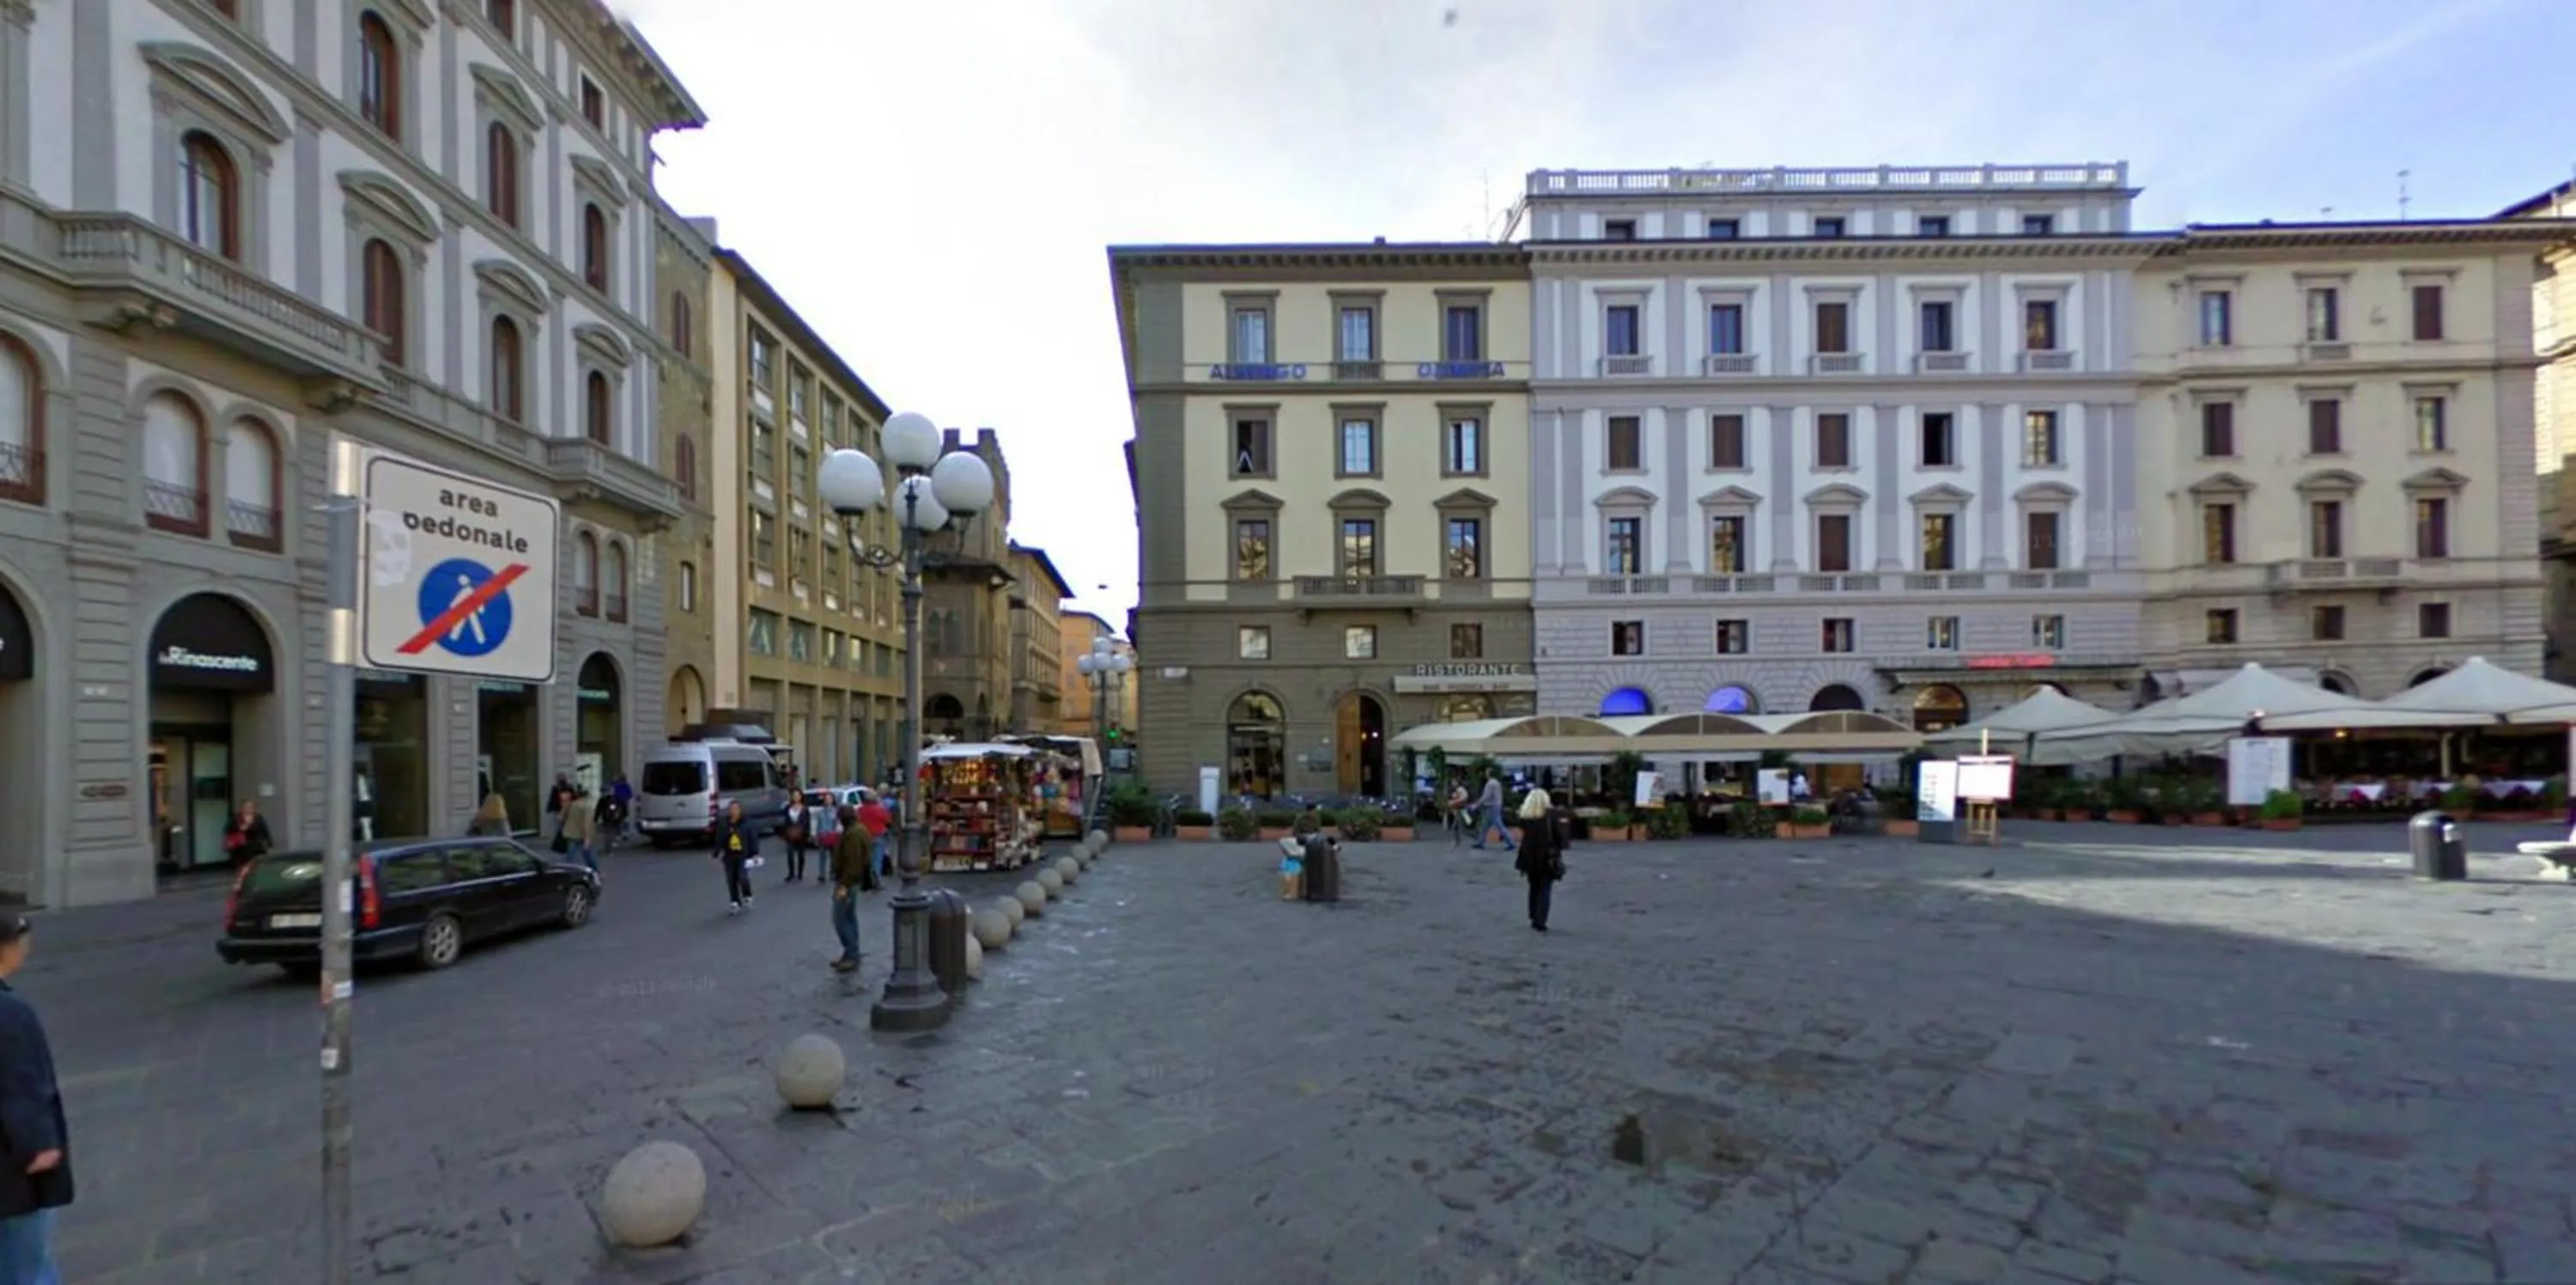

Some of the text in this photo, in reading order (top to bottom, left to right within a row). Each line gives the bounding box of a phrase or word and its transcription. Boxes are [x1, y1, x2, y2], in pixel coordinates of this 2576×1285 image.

[440, 489, 498, 518] area
[403, 510, 528, 553] pedonale
[1417, 663, 1520, 676] RISTORANTE
